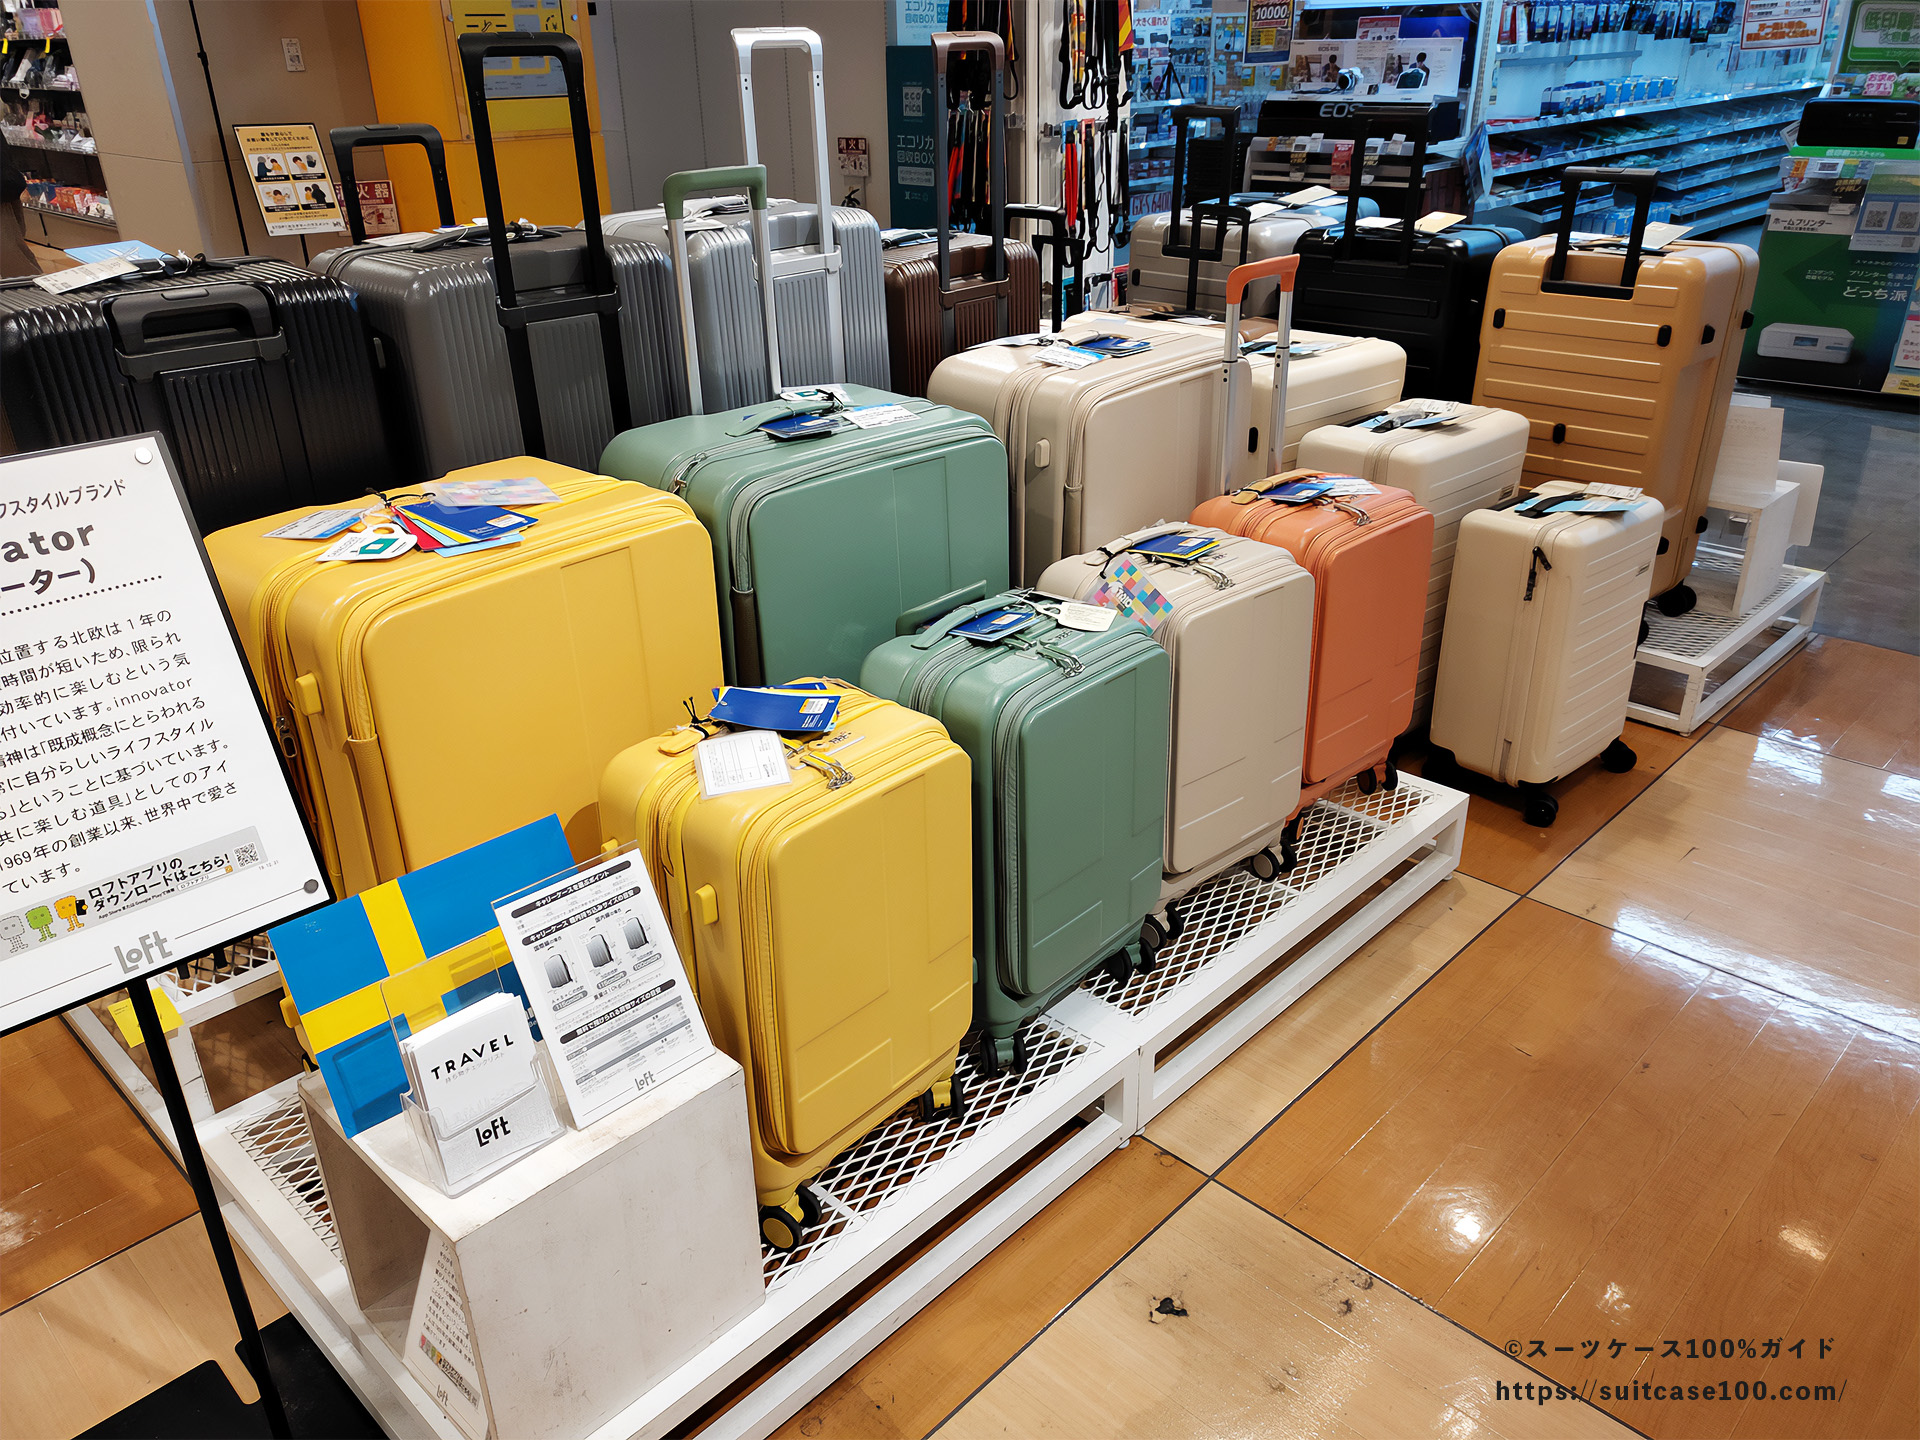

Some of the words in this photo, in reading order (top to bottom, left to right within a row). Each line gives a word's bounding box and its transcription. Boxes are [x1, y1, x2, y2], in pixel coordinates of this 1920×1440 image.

[896, 134, 934, 150] エコリカ
[1772, 217, 1833, 228] ホームプリンター
[1842, 286, 1908, 302] どっち派
[1, 524, 94, 563] ator
[0, 631, 182, 691] 時間が短いため、限られ
[2, 862, 81, 894] ています。
[88, 857, 183, 900] ロフトアプリの
[430, 1034, 514, 1080] TRAVEL
